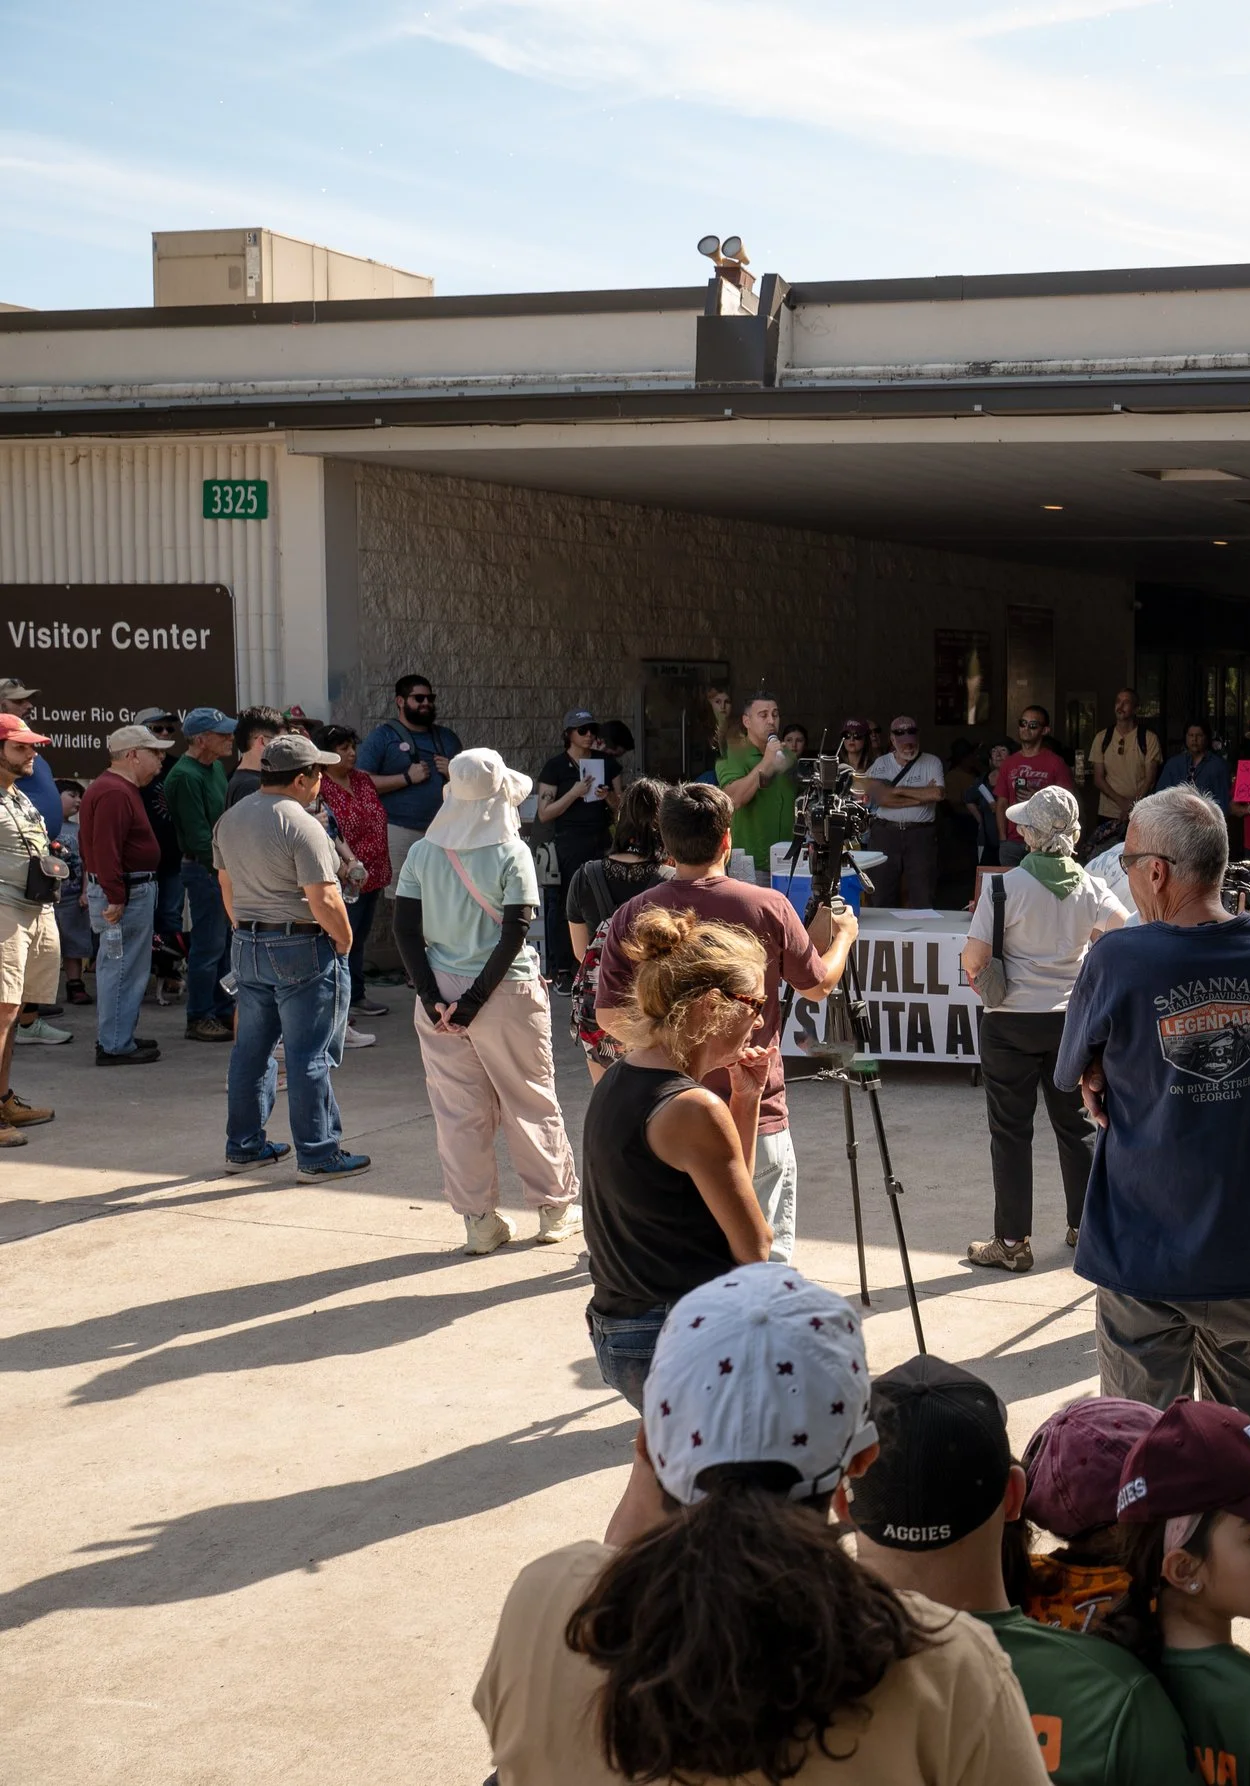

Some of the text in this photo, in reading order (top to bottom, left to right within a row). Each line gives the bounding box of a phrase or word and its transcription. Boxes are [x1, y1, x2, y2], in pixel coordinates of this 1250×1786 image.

[211, 485, 258, 514] 3325
[8, 621, 210, 650] Visitor Center
[43, 708, 86, 721] Lower
[91, 708, 114, 722] Rio
[51, 734, 101, 749] Wildlife
[794, 996, 935, 1054] SNTA
[1169, 1085, 1184, 1095] ON
[1187, 1081, 1220, 1094] RIVER
[1192, 1090, 1242, 1103] GEORGIA
[883, 1523, 951, 1542] AGGIES
